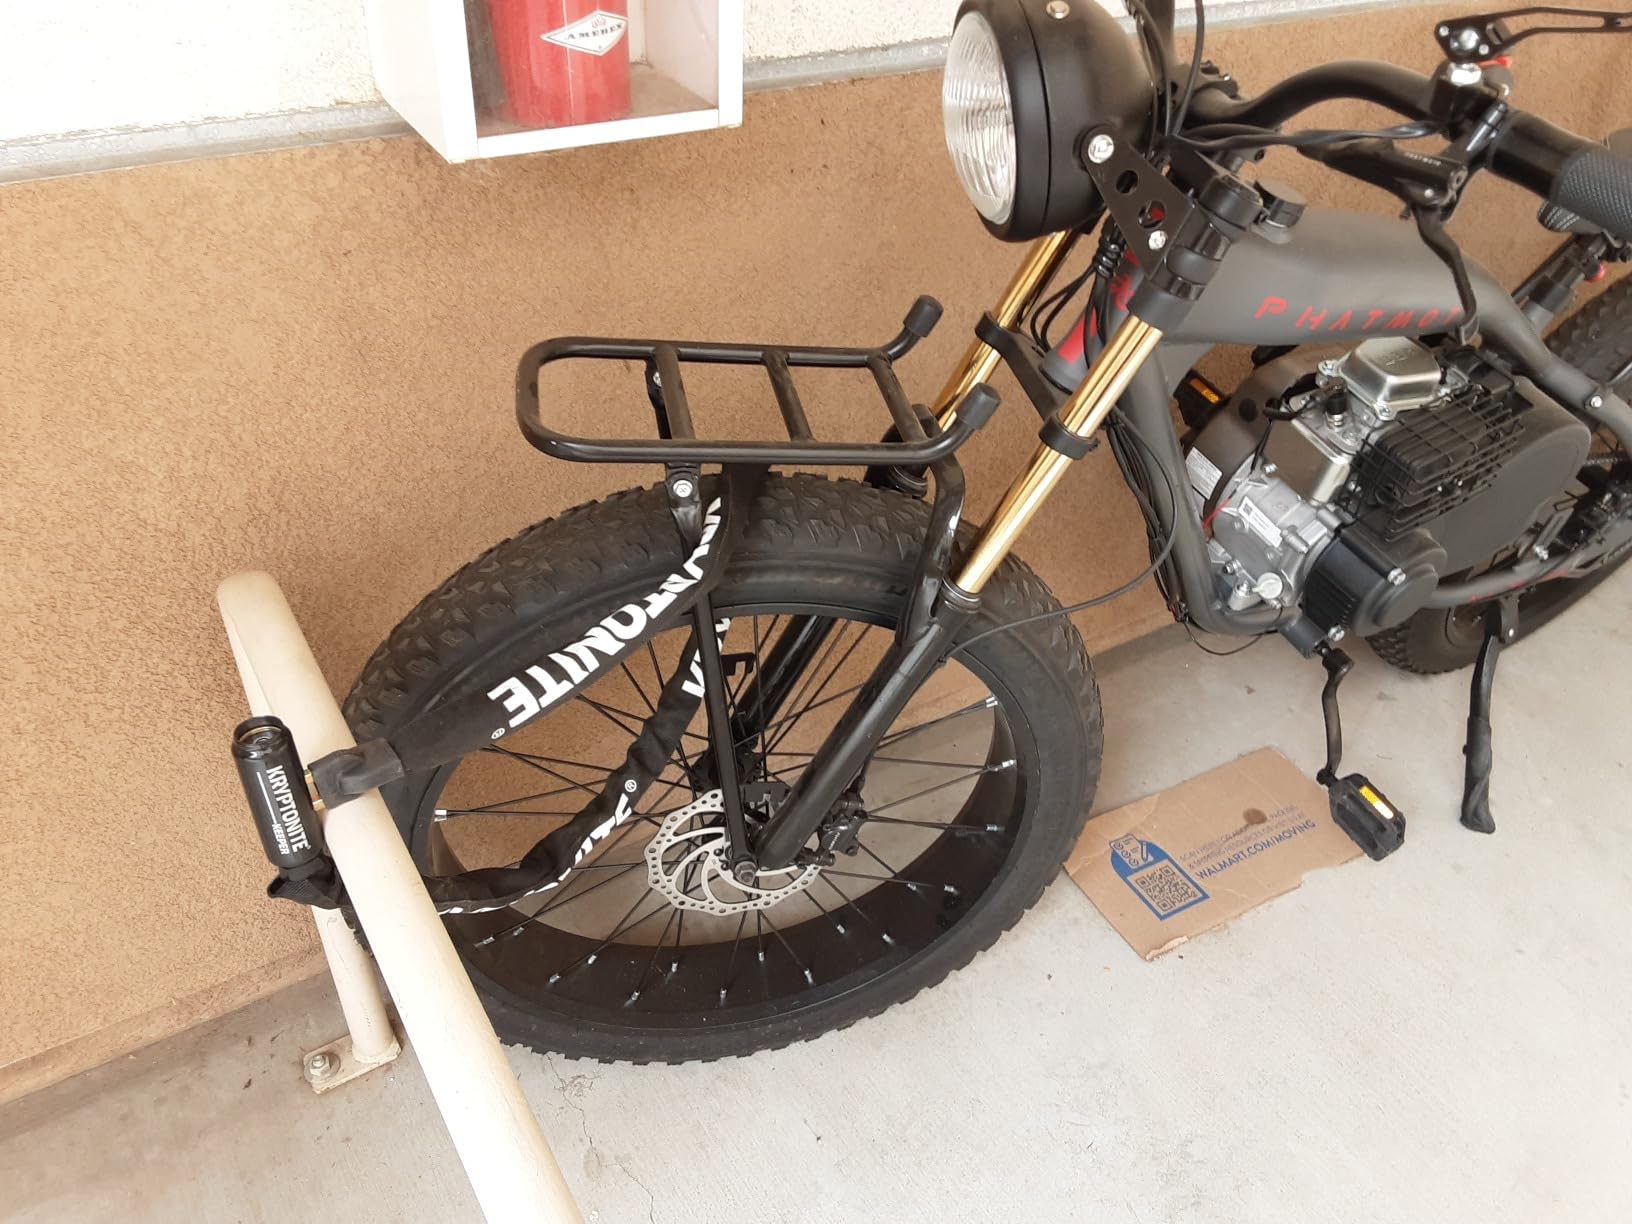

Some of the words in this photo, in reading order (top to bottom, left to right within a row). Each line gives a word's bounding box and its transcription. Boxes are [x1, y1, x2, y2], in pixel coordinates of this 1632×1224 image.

[266, 764, 309, 853] KRYPTONITE
[271, 823, 290, 855] KEEPER
[1195, 819, 1316, 879] WALMART.COM/MOVING
